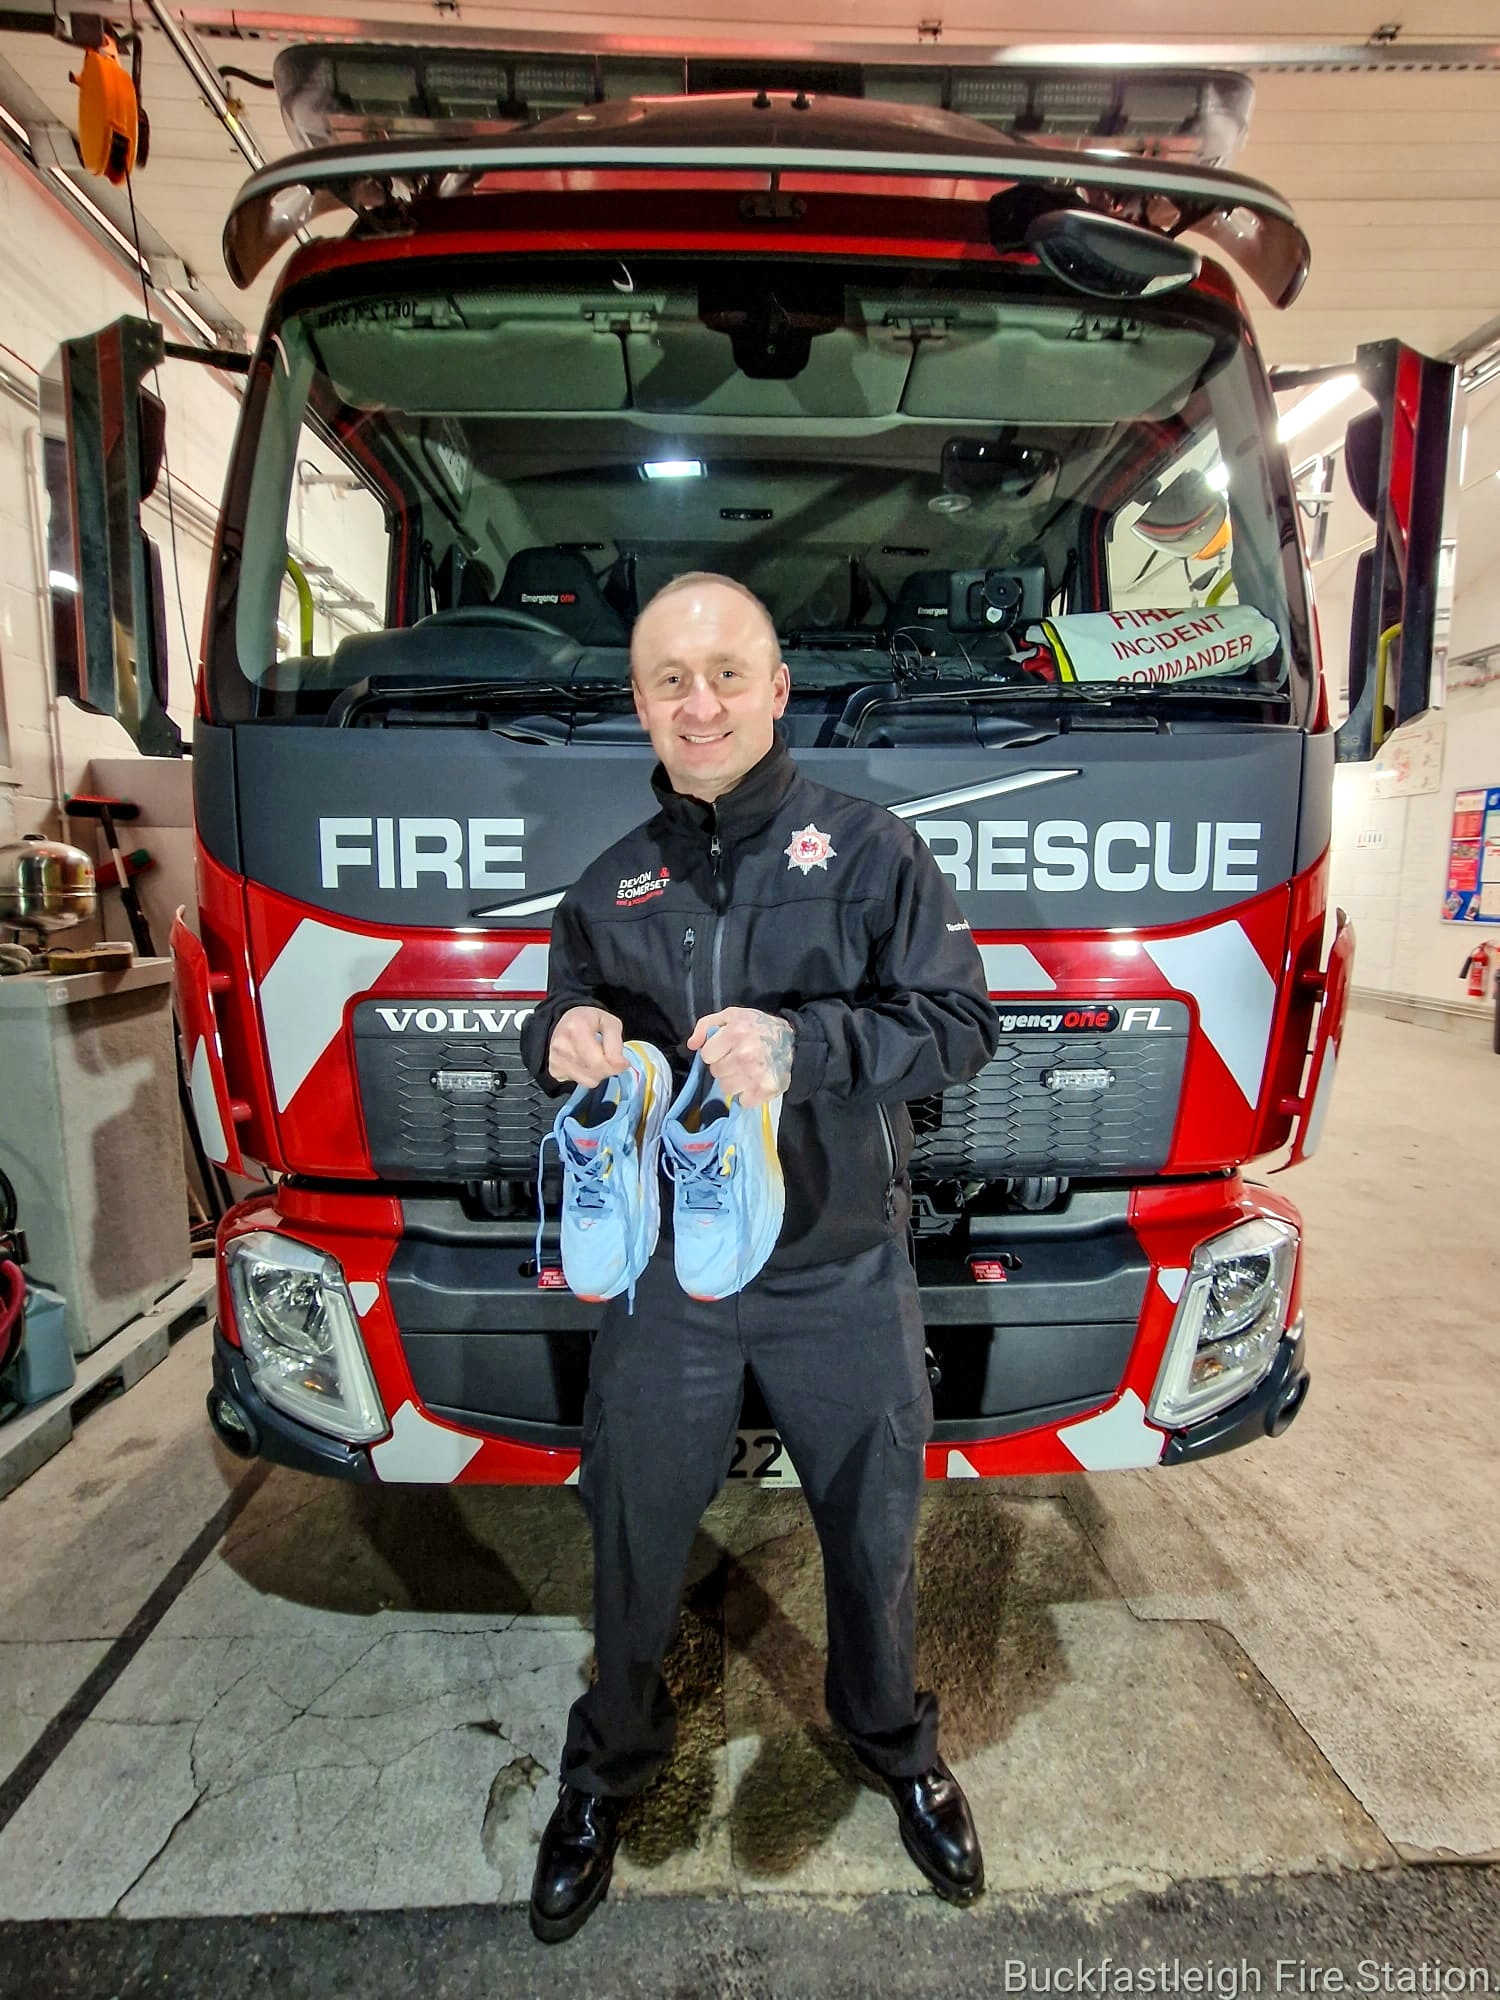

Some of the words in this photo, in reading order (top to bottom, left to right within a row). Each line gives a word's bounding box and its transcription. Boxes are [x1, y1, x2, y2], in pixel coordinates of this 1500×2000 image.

[1111, 613, 1225, 660] INCIDENT
[319, 817, 526, 889] FIRE
[915, 820, 1261, 891] RESCUE
[616, 879, 671, 899] SOMERSET
[619, 871, 652, 888] DEVON
[1064, 1011, 1111, 1028] one
[1121, 1008, 1172, 1031] FL
